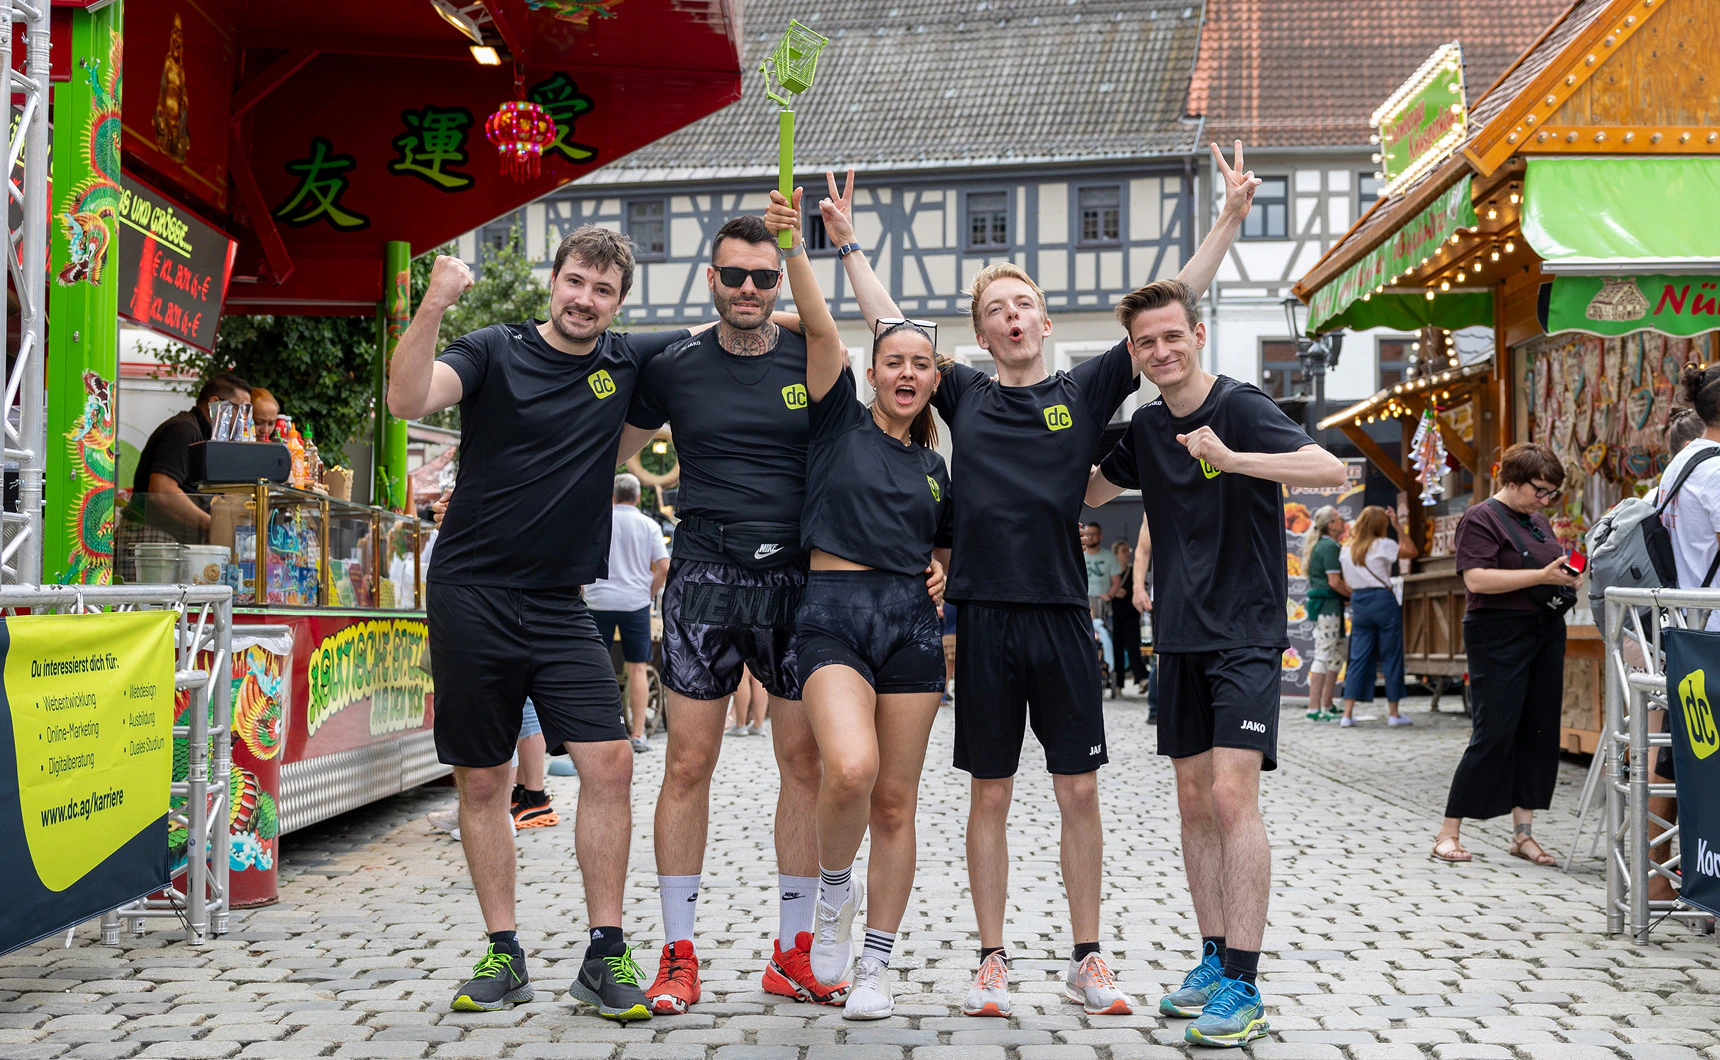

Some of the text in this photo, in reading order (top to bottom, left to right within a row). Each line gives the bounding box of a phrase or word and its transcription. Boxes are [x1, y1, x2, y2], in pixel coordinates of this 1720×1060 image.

[132, 194, 152, 229] UND
[1653, 282, 1720, 316] Nü
[592, 373, 614, 395] dc
[786, 386, 807, 406] dc
[1047, 407, 1070, 427] dc
[759, 543, 779, 553] NIKE
[31, 652, 120, 678] Du interessierst dich für:
[129, 682, 157, 700] Webdesign
[42, 692, 97, 712] Webentwicklung
[1686, 679, 1716, 744] dc
[128, 711, 156, 728] Ausbildung
[1240, 719, 1266, 733] JAKO
[46, 720, 100, 743] Online-Marketing
[129, 736, 165, 757] Duales Studium
[48, 752, 95, 778] Digitalberatung
[40, 787, 124, 828] www.dc.ag/karriere
